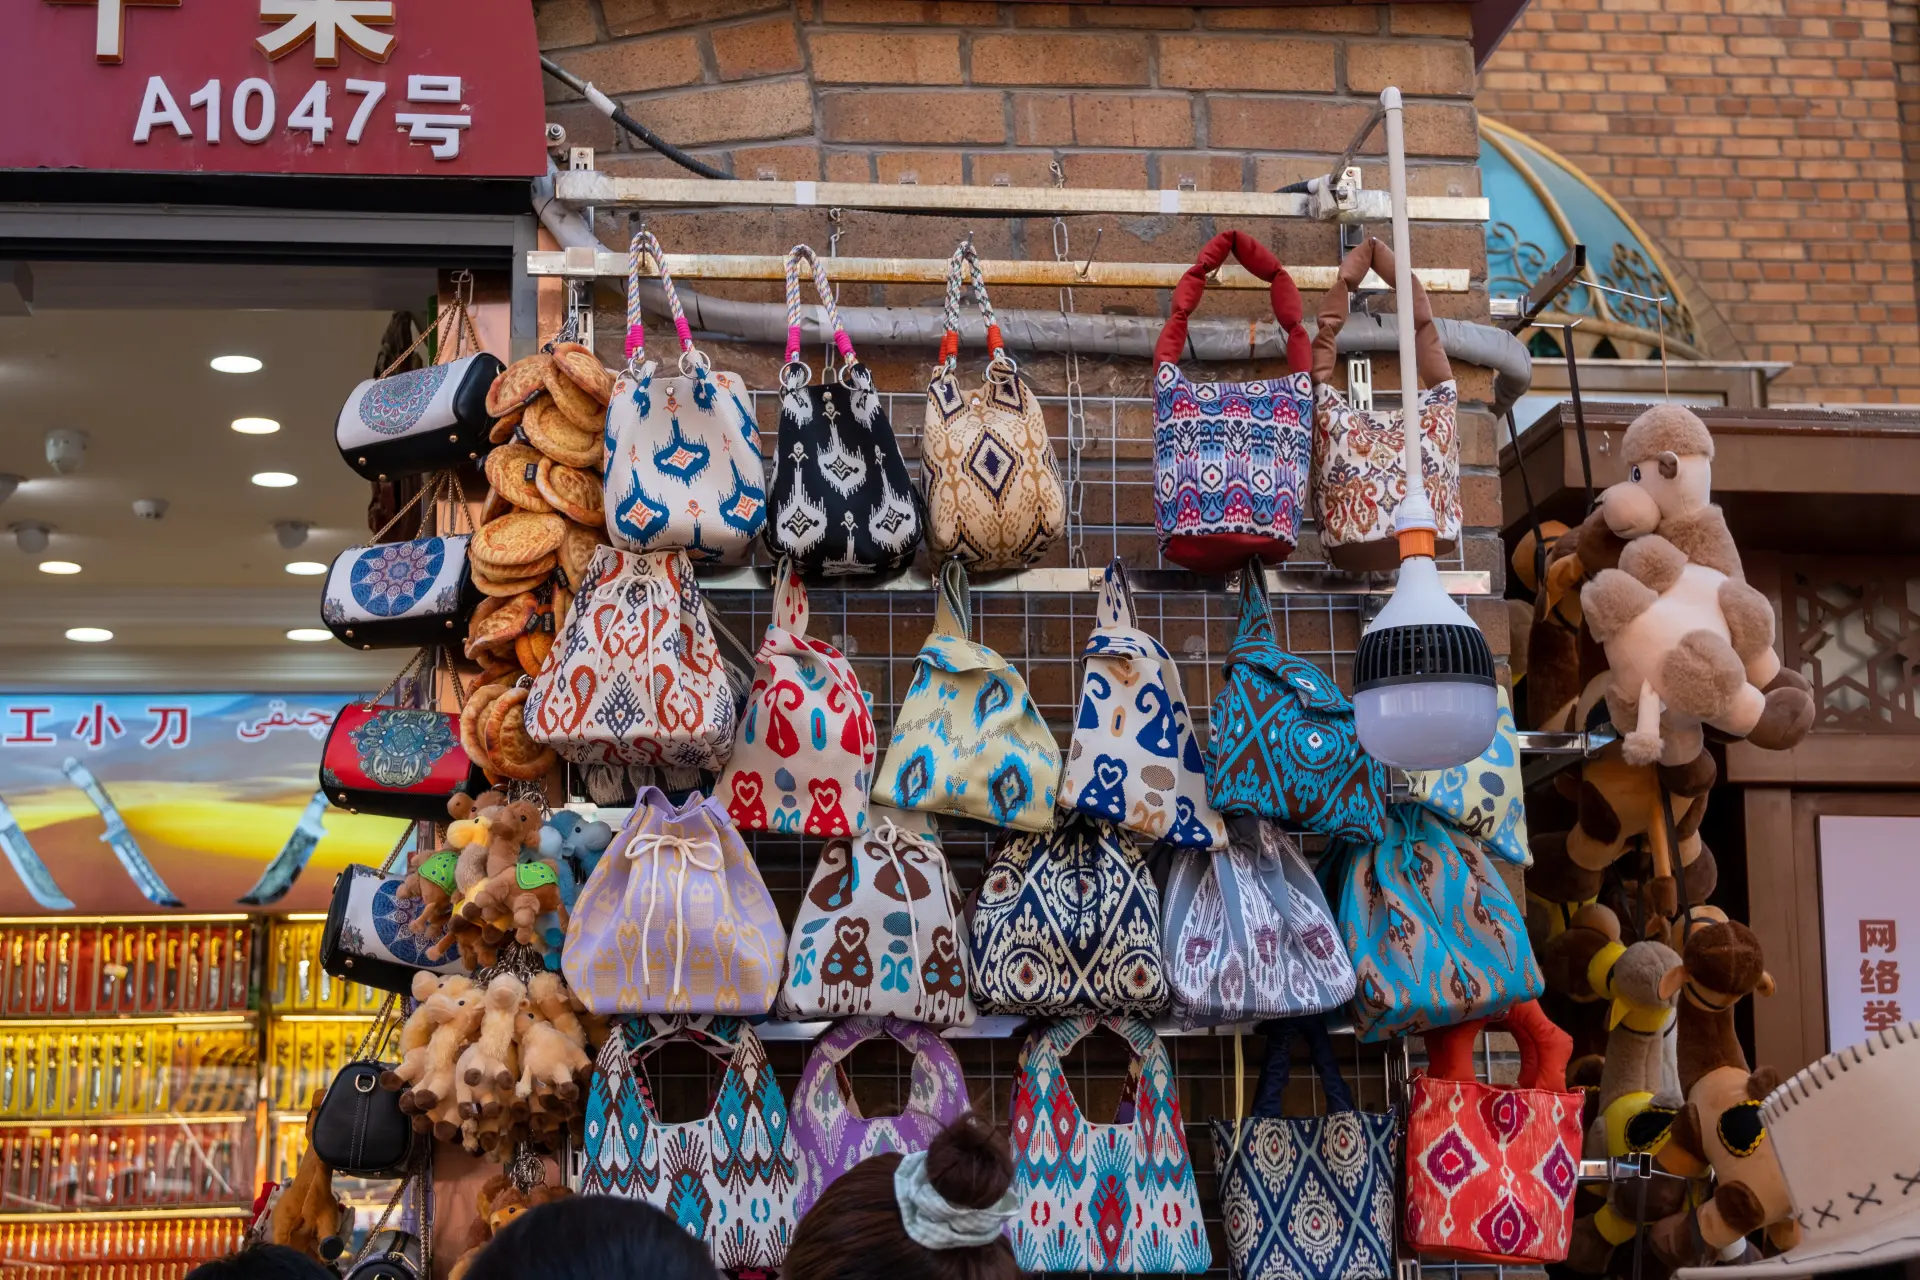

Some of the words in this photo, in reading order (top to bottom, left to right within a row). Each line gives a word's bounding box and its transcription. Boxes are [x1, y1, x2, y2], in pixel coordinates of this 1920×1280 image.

[133, 74, 472, 161] A1047号
[5, 703, 191, 748] 工小刀
[1858, 919, 1902, 1032] 网络举
